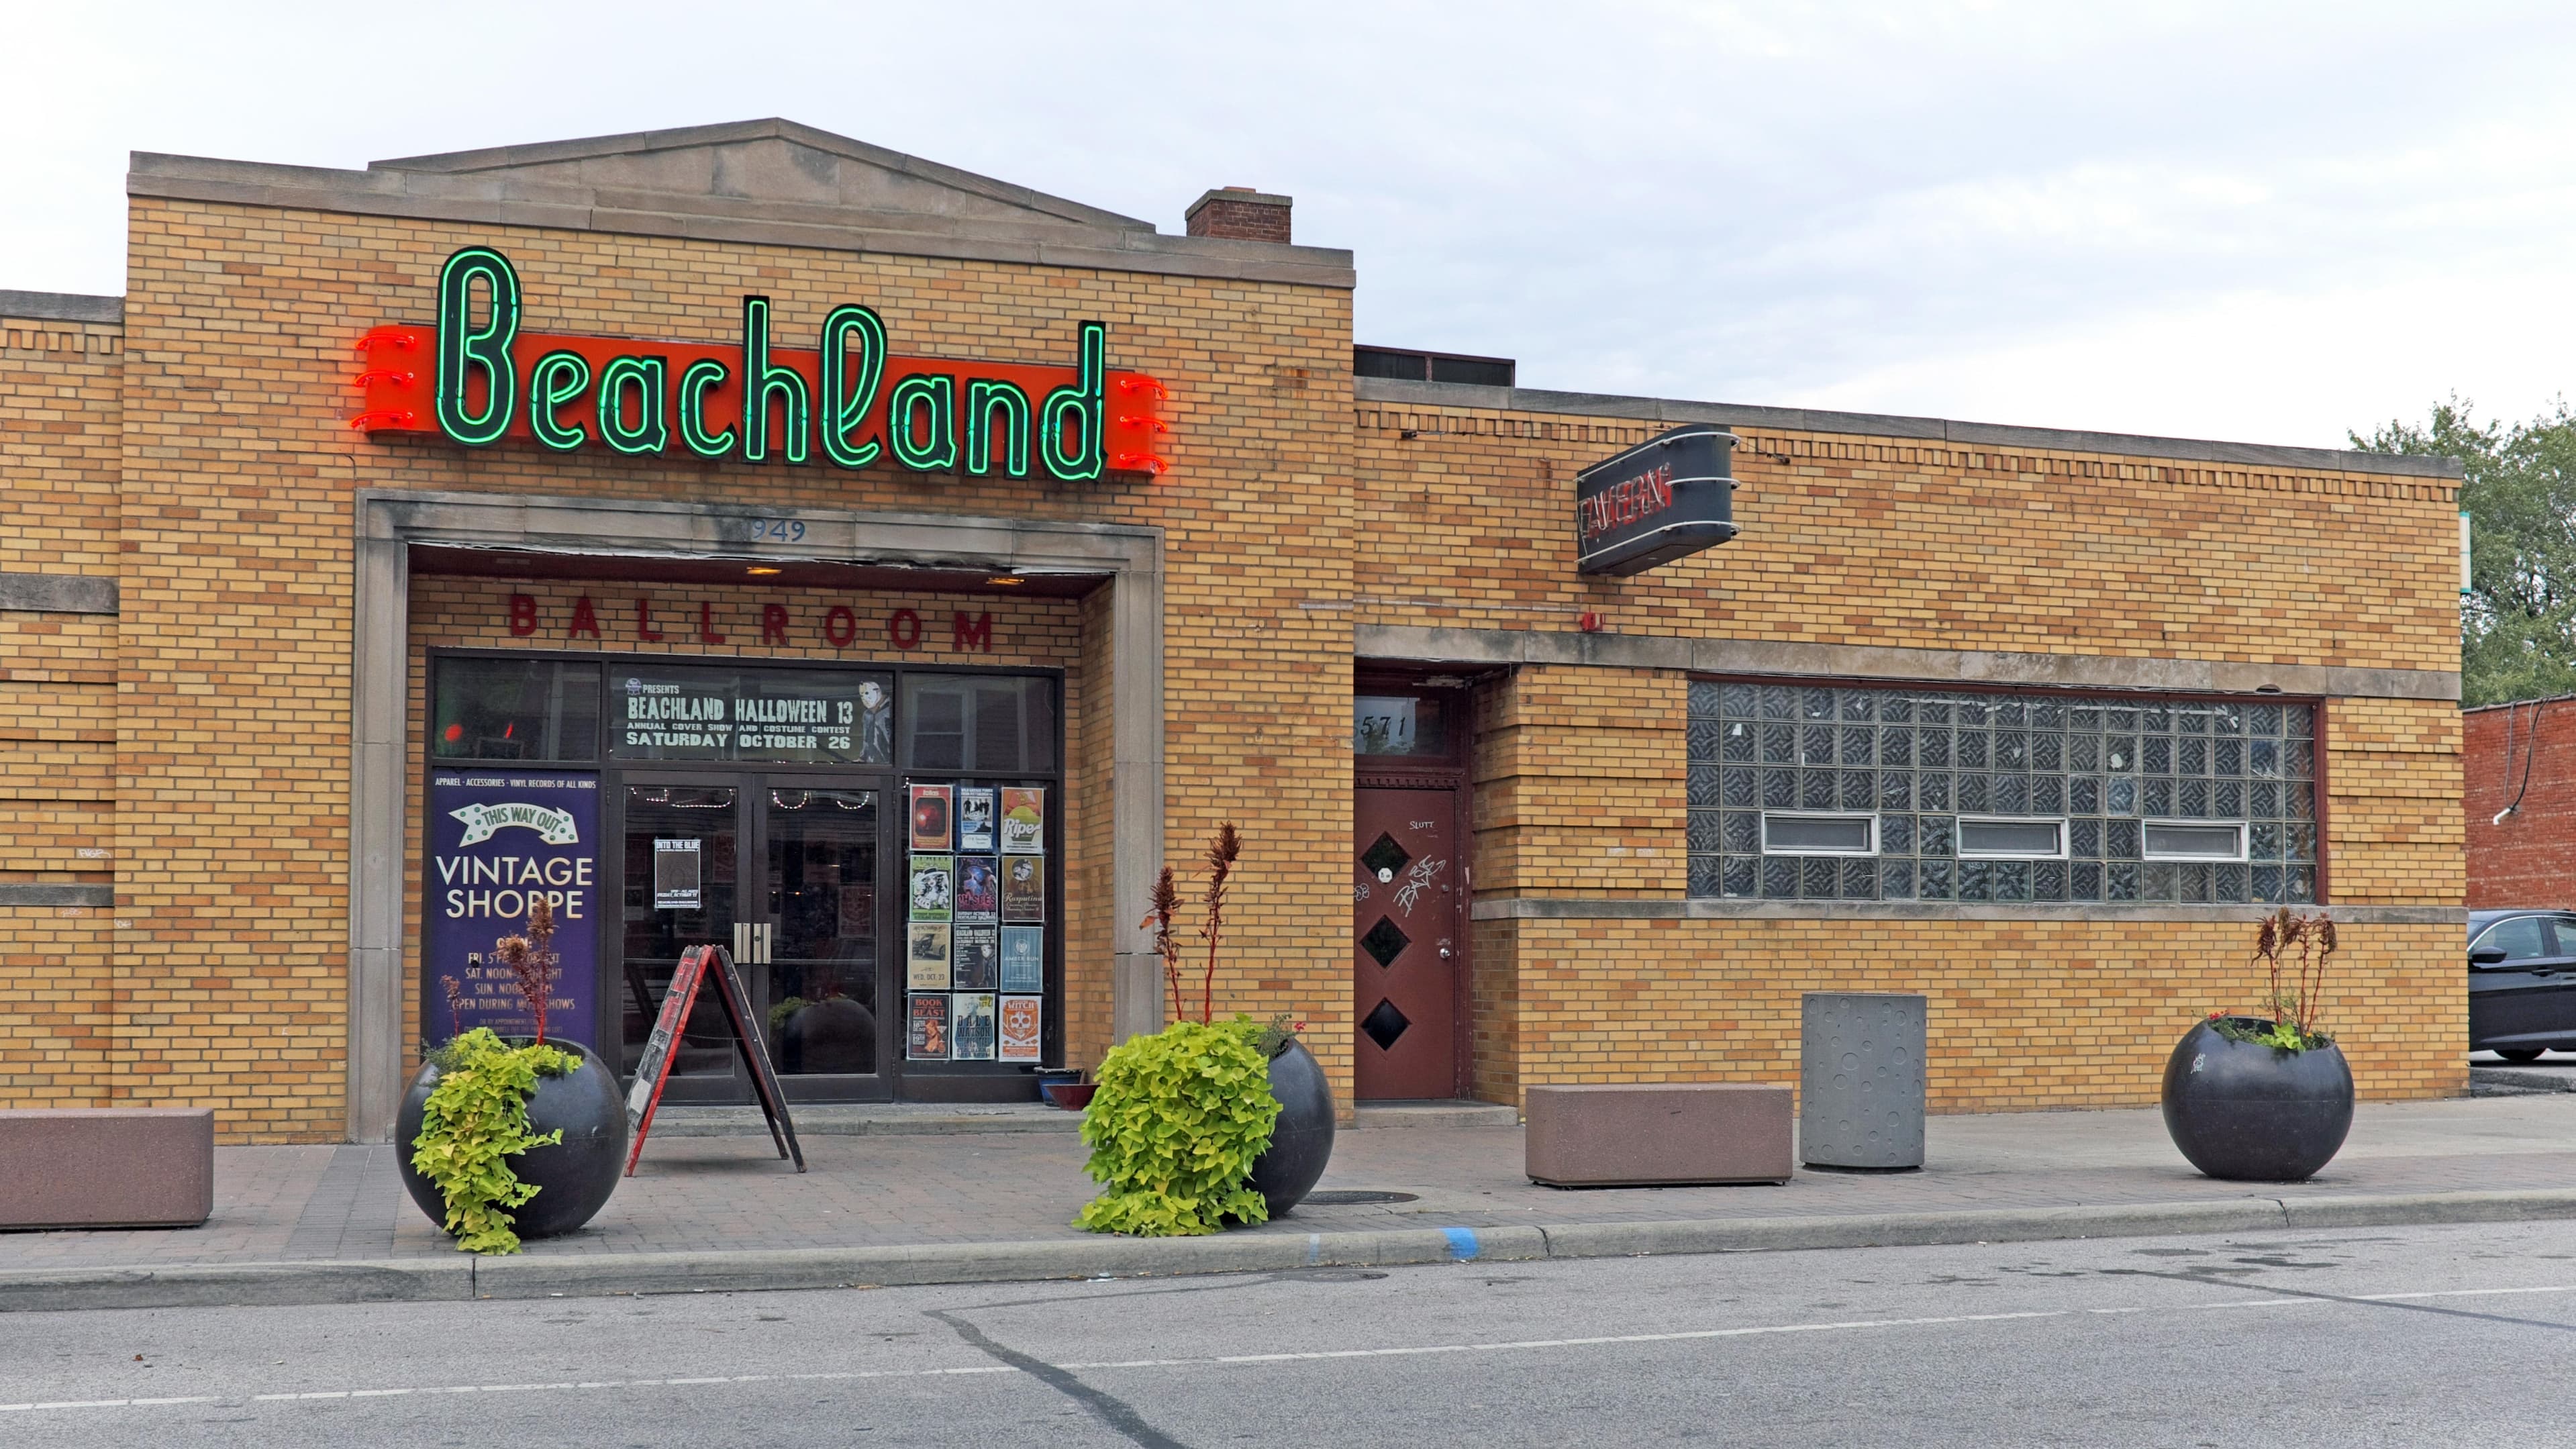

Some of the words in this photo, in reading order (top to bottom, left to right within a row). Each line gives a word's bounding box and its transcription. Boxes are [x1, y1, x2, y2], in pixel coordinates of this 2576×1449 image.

[436, 246, 1107, 483] Beachland
[1578, 463, 1672, 538] TAVERN
[510, 595, 991, 652] BALLROOM
[642, 684, 680, 695] PRESENTS
[628, 697, 724, 721] BEACHLAND
[735, 699, 827, 723] HALLOWEEN
[837, 701, 853, 724] 13
[672, 723, 702, 731] COVER
[708, 723, 733, 732] SHOW
[738, 724, 758, 732] AND
[763, 725, 805, 733] COSTUME
[626, 732, 728, 747] SATURDAY
[740, 734, 817, 749] OCTOBER
[828, 736, 850, 749] 26
[435, 778, 461, 786] APPAREL
[466, 779, 505, 787] ACCESSORIES
[510, 779, 527, 787] VINYL
[528, 780, 556, 788] RECORDS
[566, 781, 577, 789] ALL
[578, 781, 597, 789] KINDS
[481, 807, 509, 826] THIS
[511, 807, 537, 823] WAY
[537, 812, 562, 833] OUT
[1004, 819, 1042, 838] Ripe
[436, 855, 593, 886] VINTAGE
[446, 889, 583, 919] SHOPPE
[465, 968, 483, 979] SAT.
[475, 983, 495, 995] SUN.
[479, 998, 513, 1010] DURING
[958, 1027, 990, 1037] WATSON
